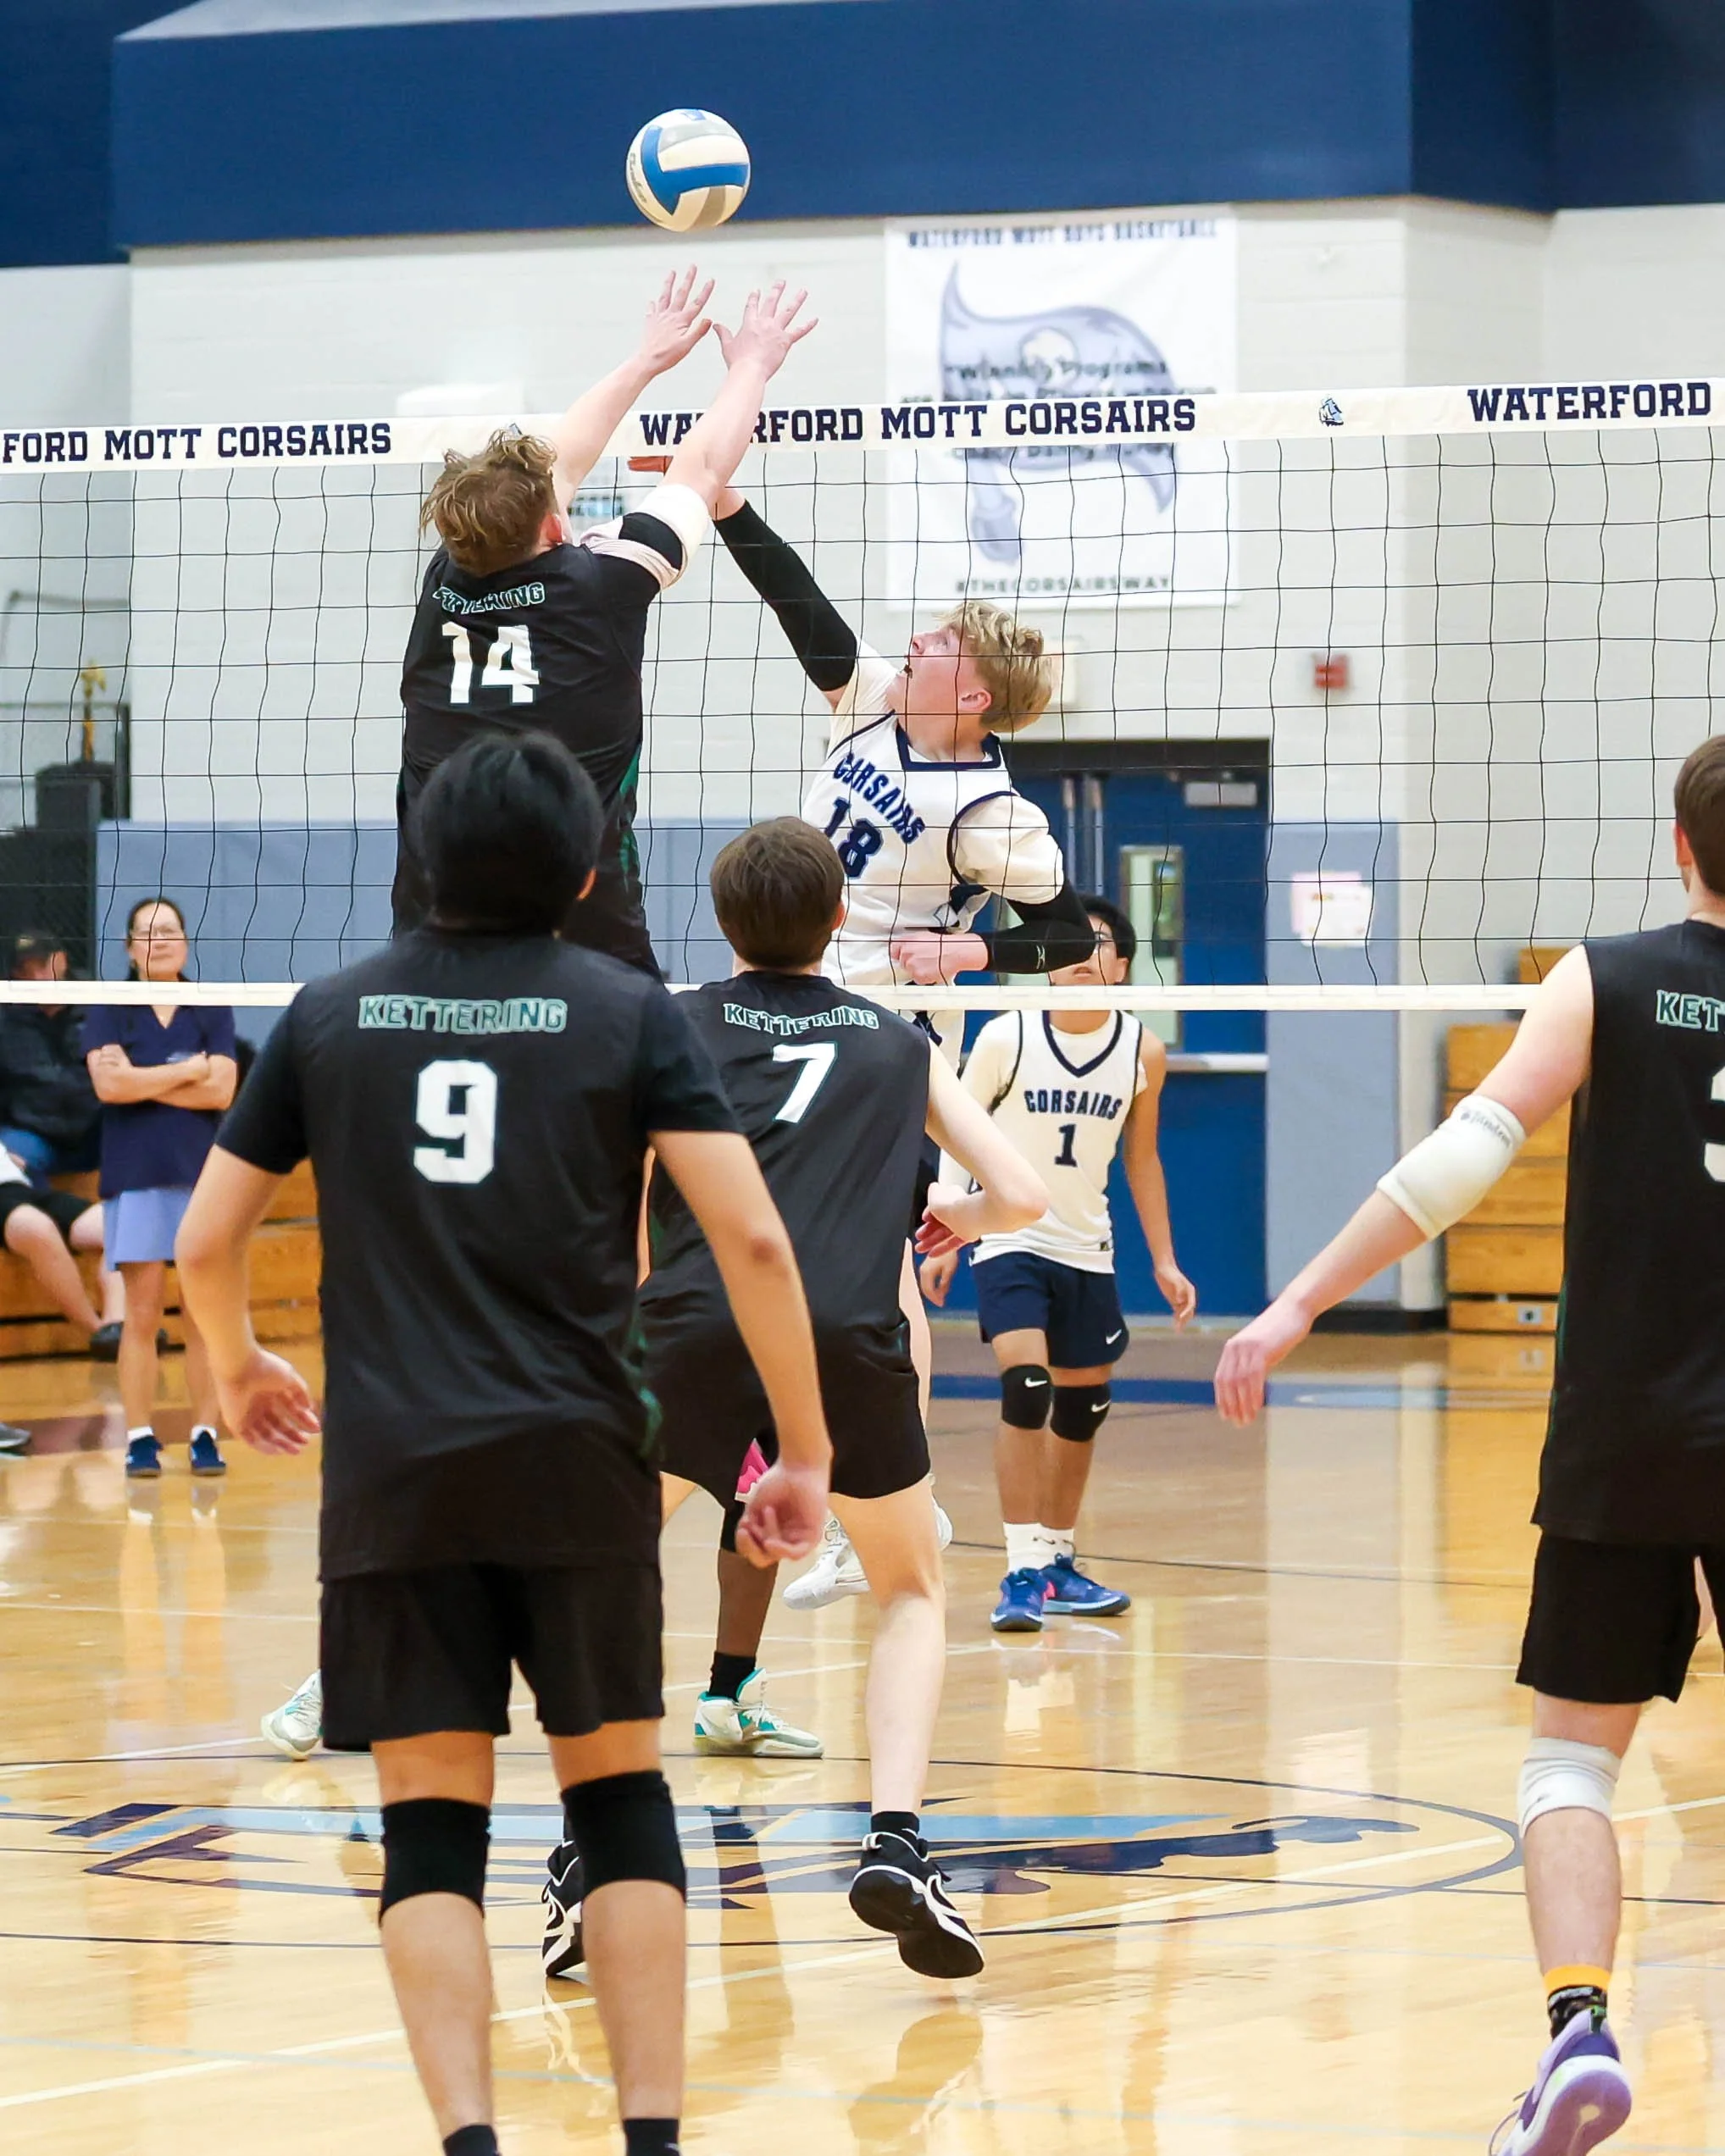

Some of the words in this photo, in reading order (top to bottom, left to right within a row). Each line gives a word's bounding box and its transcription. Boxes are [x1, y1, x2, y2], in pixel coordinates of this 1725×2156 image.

[640, 407, 863, 446] WARFORD
[880, 405, 987, 440] MOTT
[1005, 398, 1195, 435] CORSAIRS
[1467, 381, 1711, 422] WATERFORD
[2, 430, 88, 463] FORD
[104, 428, 202, 461] MOTT
[217, 422, 392, 458] CORSAIRS
[441, 620, 540, 705] 14
[833, 752, 926, 845] CORSAIRS
[824, 796, 884, 879] 18
[358, 994, 568, 1035] KETTERING
[723, 1002, 879, 1036] KETTERING
[1655, 989, 1725, 1033] KET
[772, 1040, 838, 1124] 7
[1023, 1089, 1123, 1120] CORSAIRS
[413, 1059, 498, 1184] 9
[1054, 1122, 1078, 1167] 1
